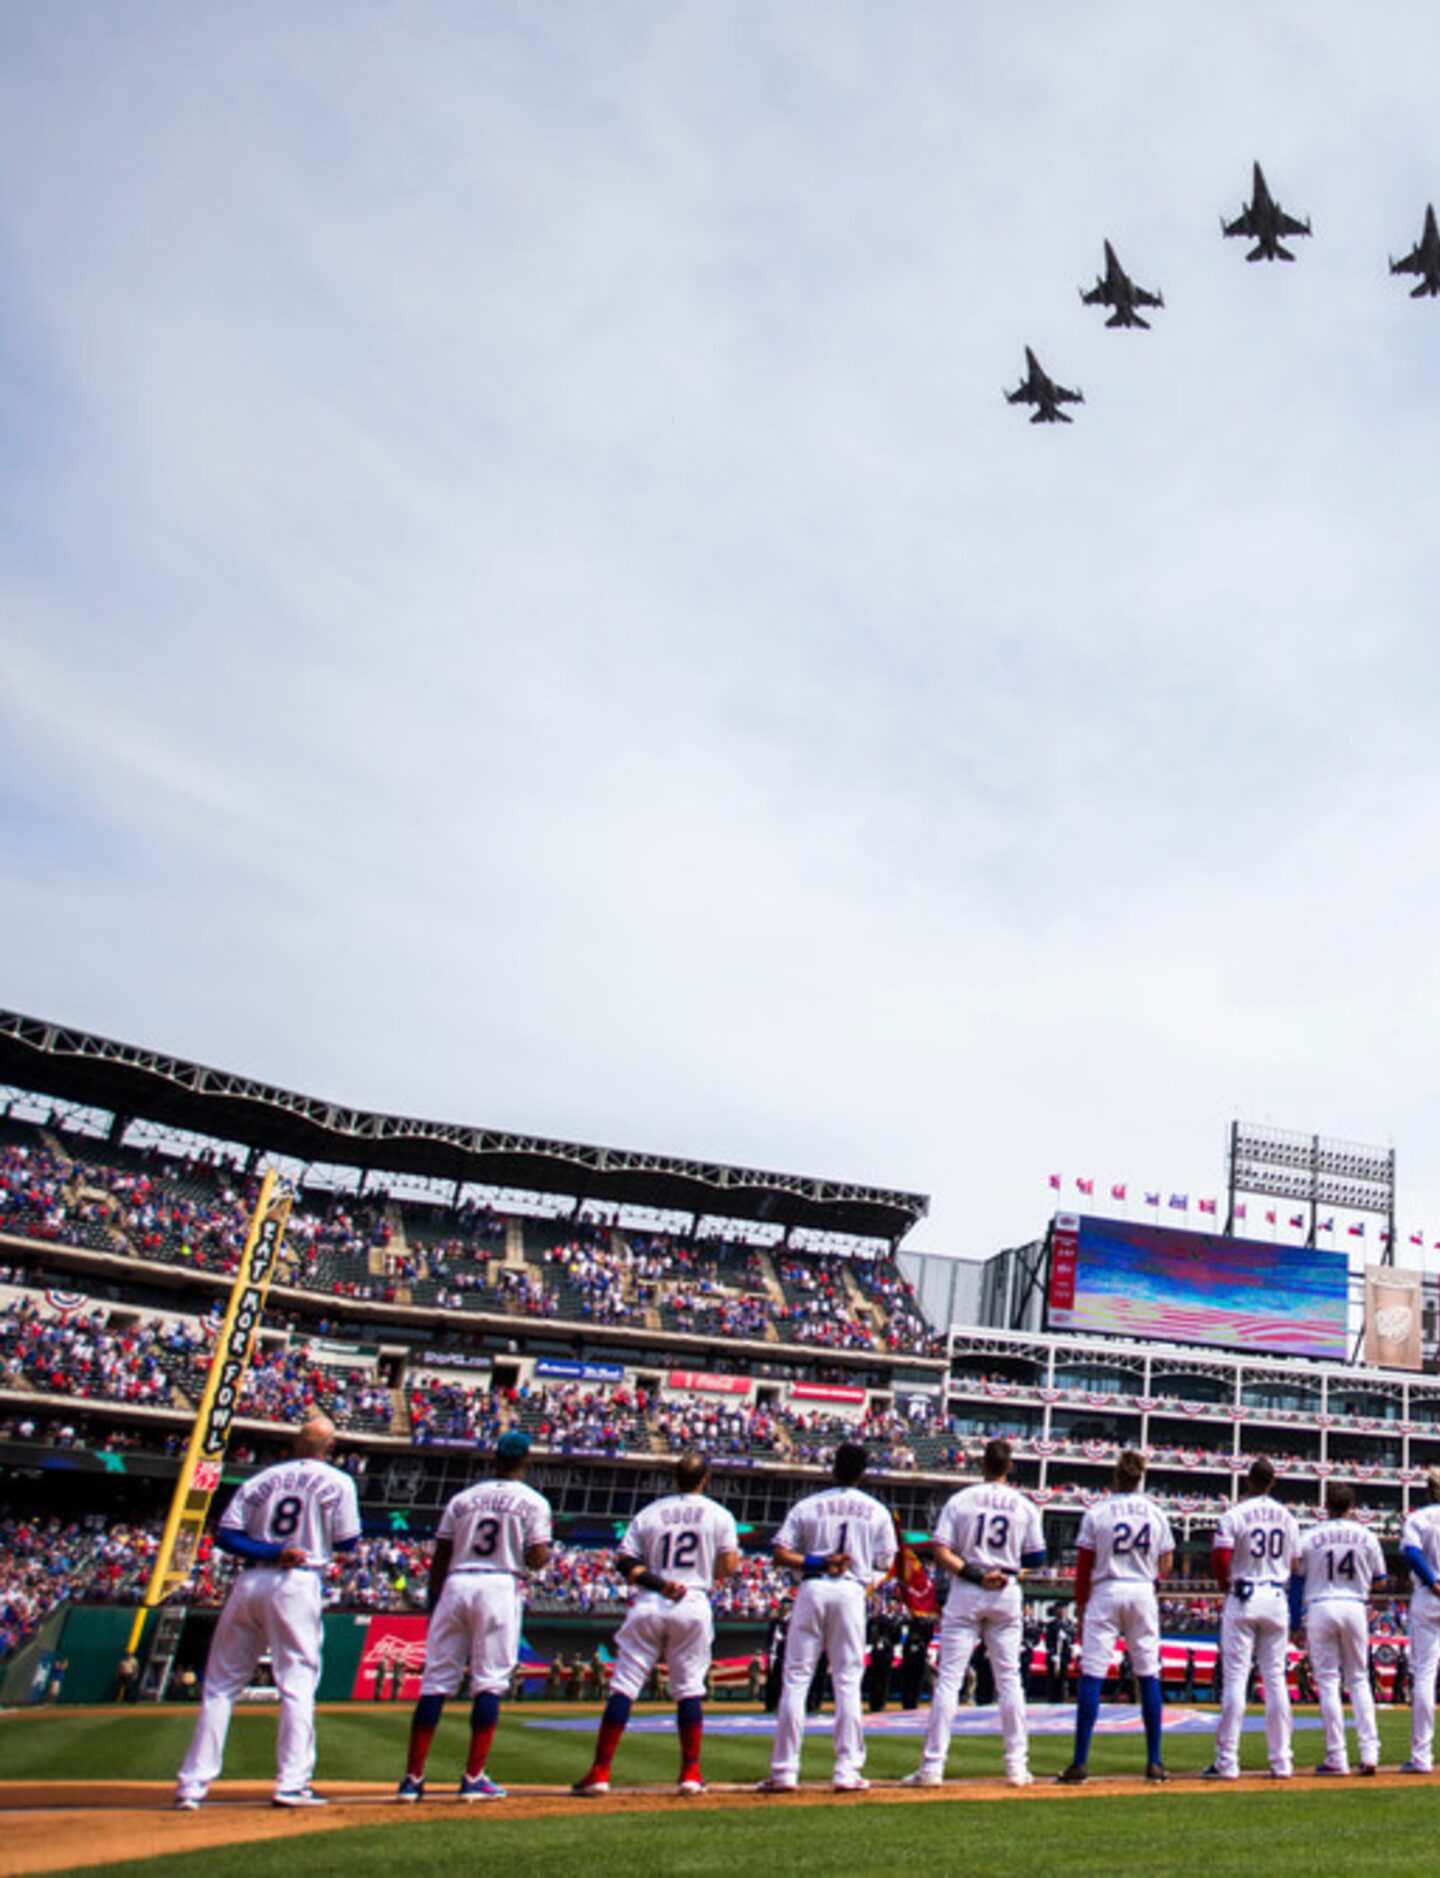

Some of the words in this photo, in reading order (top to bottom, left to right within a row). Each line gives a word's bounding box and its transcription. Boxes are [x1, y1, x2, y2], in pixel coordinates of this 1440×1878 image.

[252, 1221, 277, 1282] EAT
[230, 1290, 259, 1354] MOR
[207, 1363, 241, 1451] FOWL
[272, 1495, 303, 1537] 8
[975, 1512, 1010, 1550] 13
[472, 1517, 500, 1557] 3
[659, 1529, 700, 1569] 12
[837, 1520, 848, 1555] 1
[1112, 1522, 1151, 1555] 24
[1250, 1527, 1284, 1559] 30
[1325, 1548, 1356, 1581] 14
